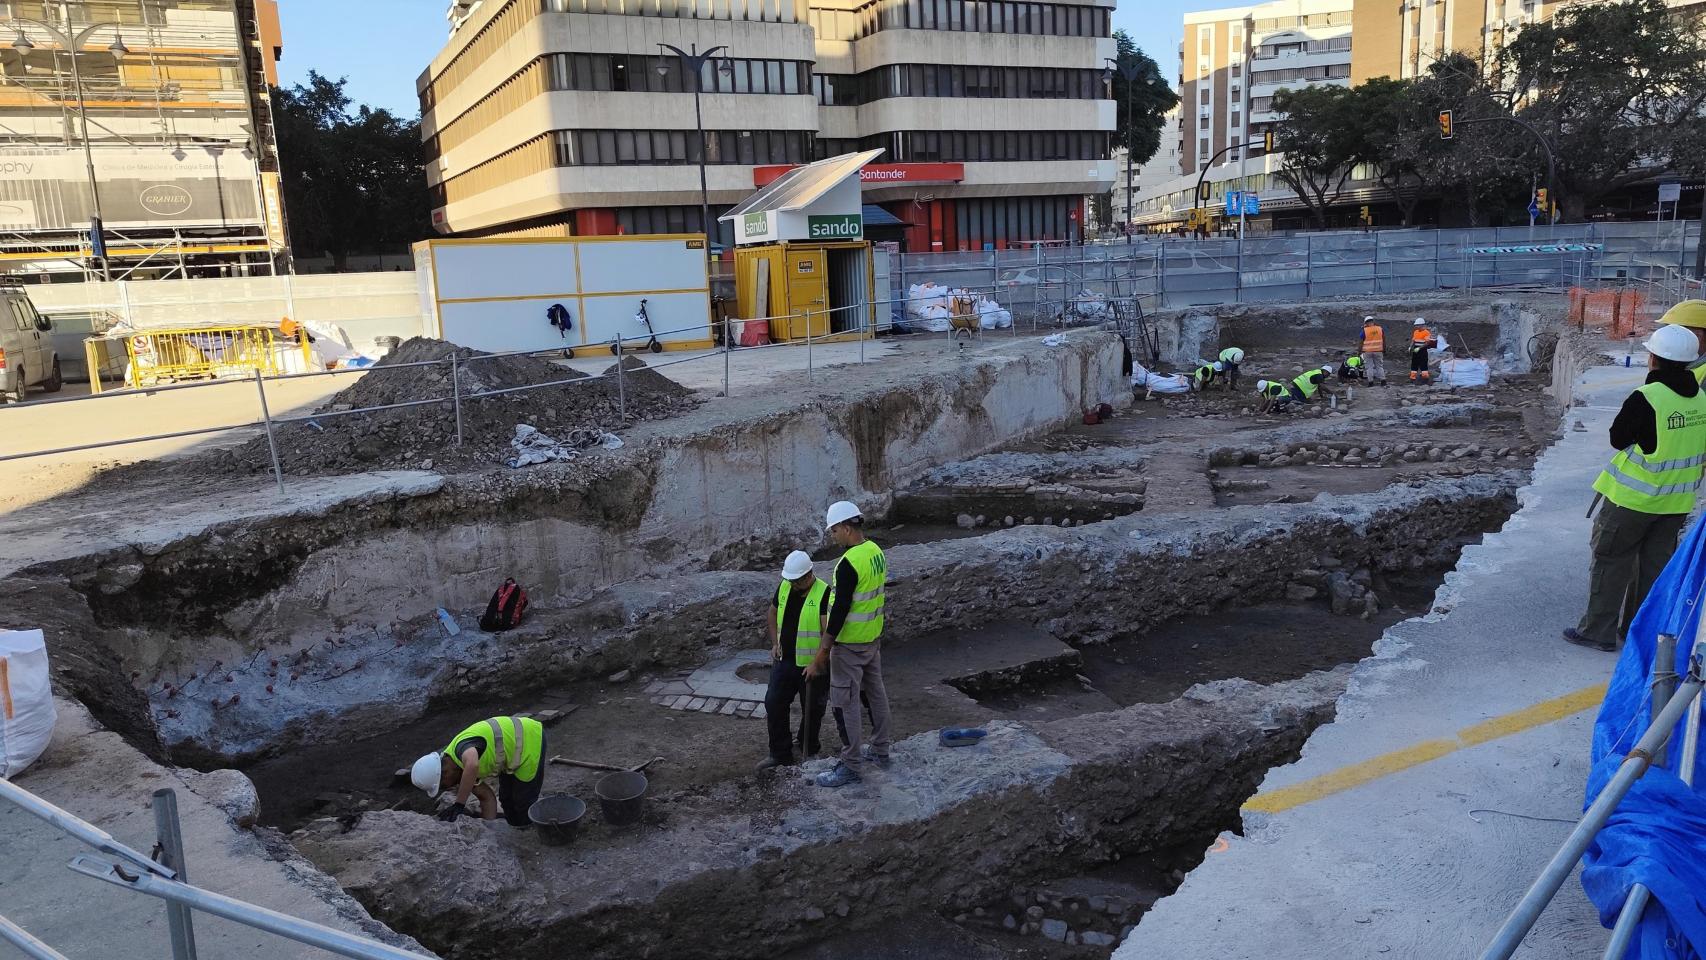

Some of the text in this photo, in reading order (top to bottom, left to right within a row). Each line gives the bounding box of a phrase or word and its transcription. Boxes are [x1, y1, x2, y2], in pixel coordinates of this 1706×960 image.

[859, 168, 907, 179] Santander
[145, 195, 187, 204] GRANIER
[745, 217, 767, 234] sando
[812, 217, 859, 236] sando
